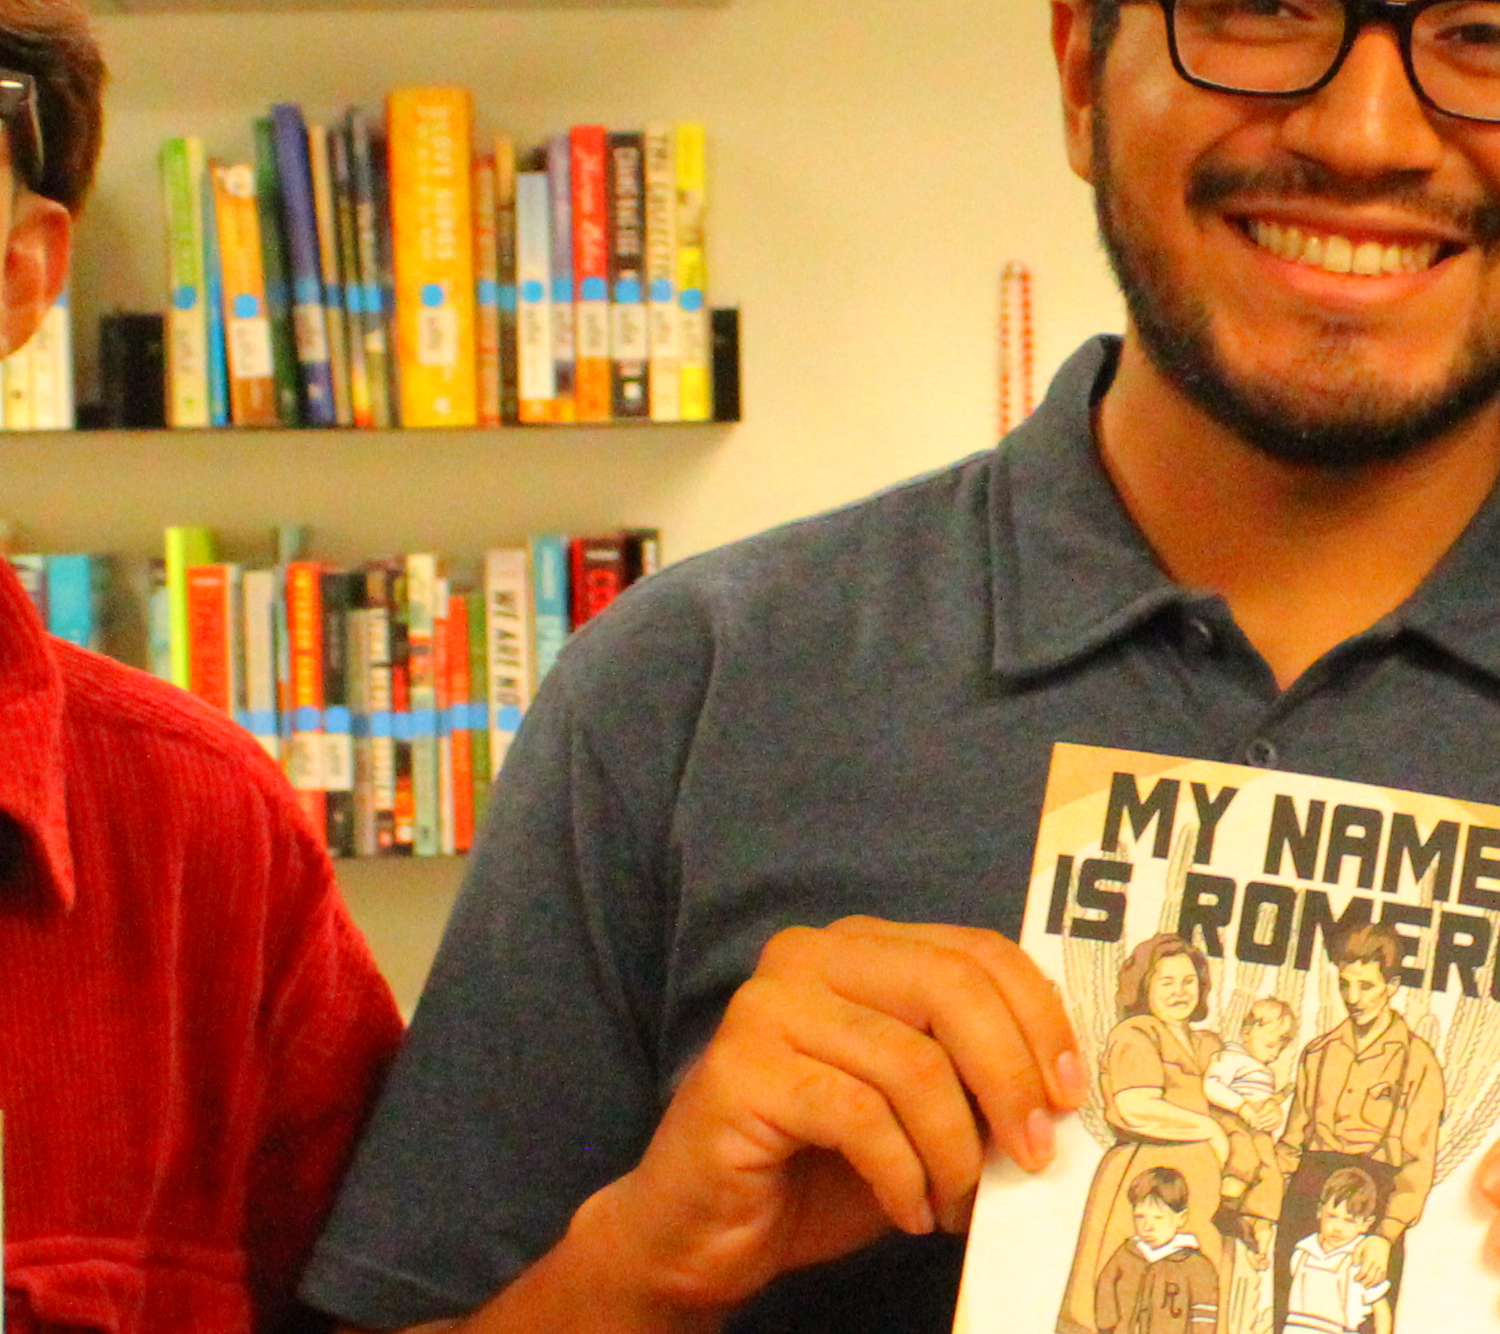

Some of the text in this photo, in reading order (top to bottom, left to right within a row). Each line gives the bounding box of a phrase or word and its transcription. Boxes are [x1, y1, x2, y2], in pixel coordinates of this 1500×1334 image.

[494, 592, 520, 620] WE
[496, 629, 521, 668] ARE
[1101, 772, 1237, 865] MY
[1045, 853, 1131, 943] IS
